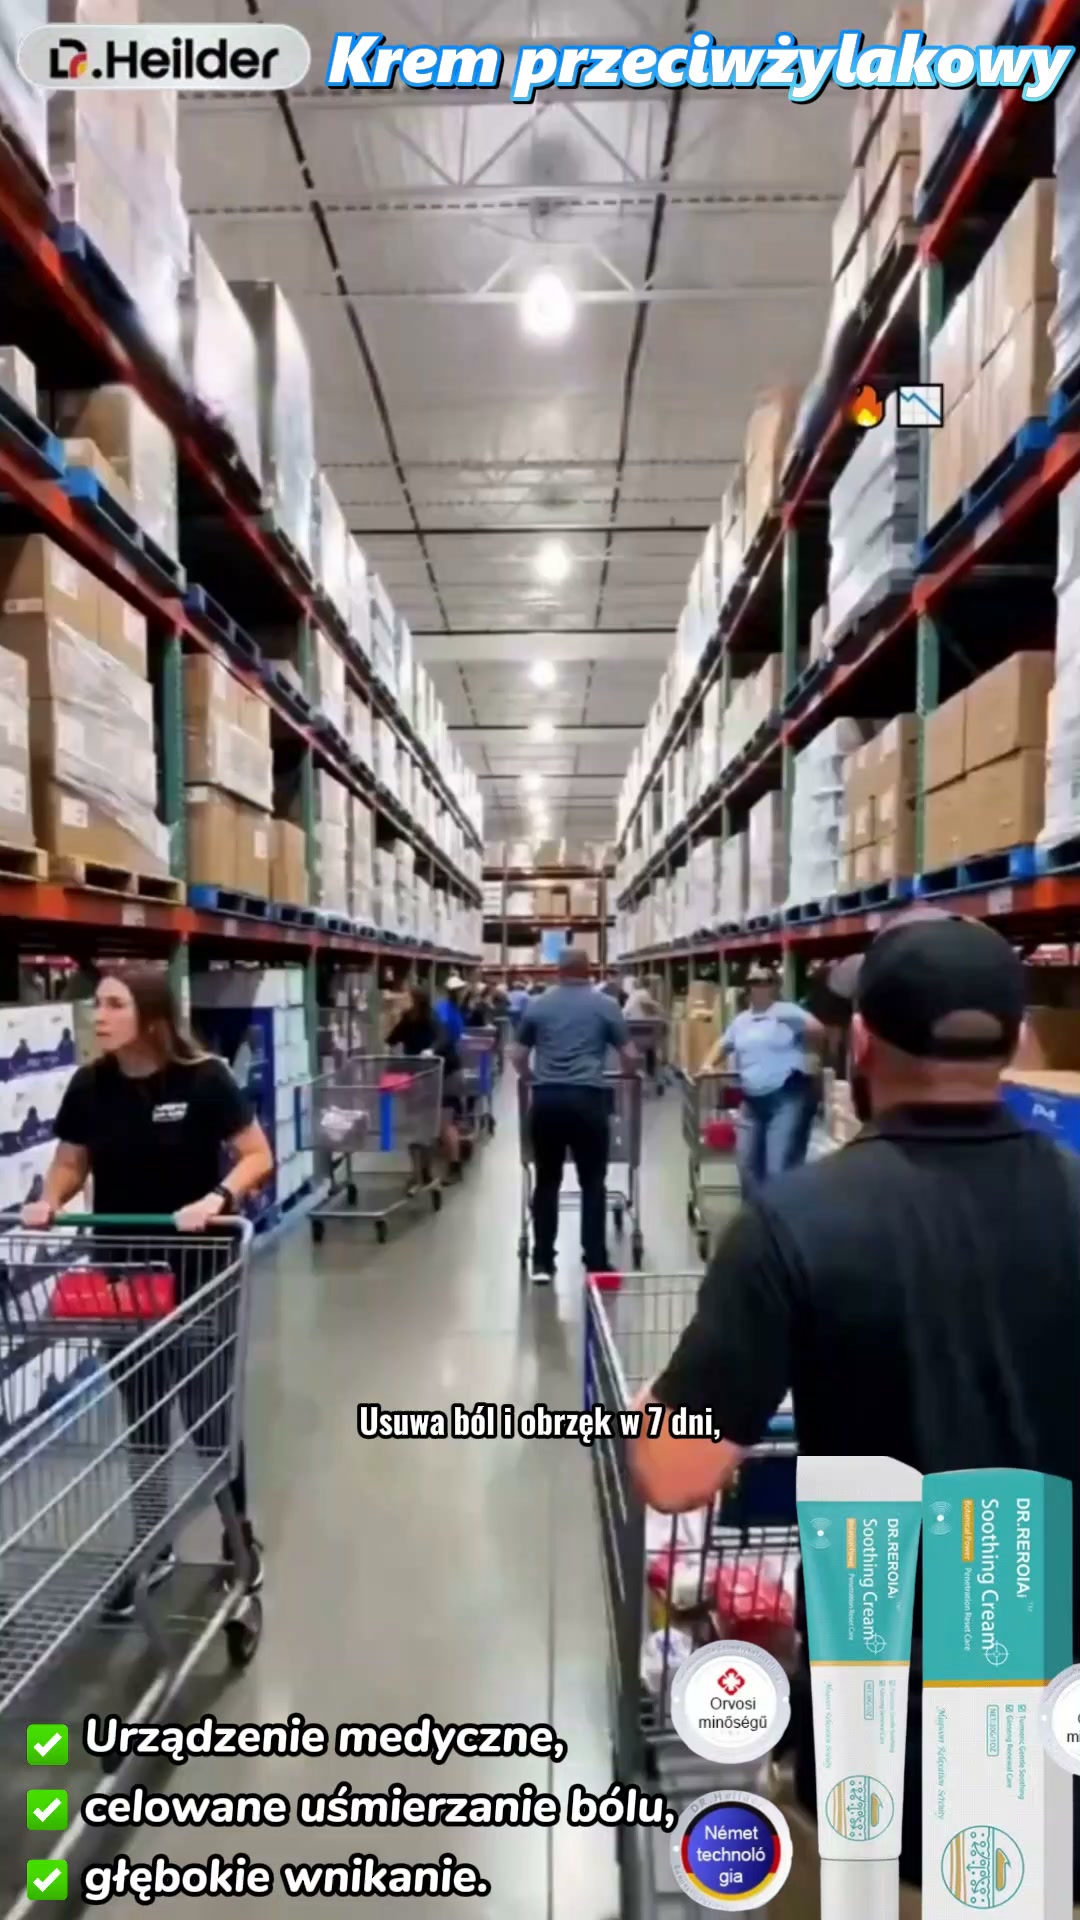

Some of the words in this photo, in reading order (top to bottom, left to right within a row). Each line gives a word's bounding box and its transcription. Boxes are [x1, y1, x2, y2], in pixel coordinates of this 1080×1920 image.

[859, 1518, 878, 1588] Soothing
[977, 1498, 1000, 1584] Soothing
[963, 1567, 973, 1611] Penetration
[863, 1591, 878, 1641] Cream
[963, 1612, 973, 1632] Reset
[981, 1589, 999, 1651] Cream
[963, 1633, 973, 1651] Care
[1018, 1745, 1026, 1768] Gentle
[1017, 1769, 1026, 1800] Soothing
